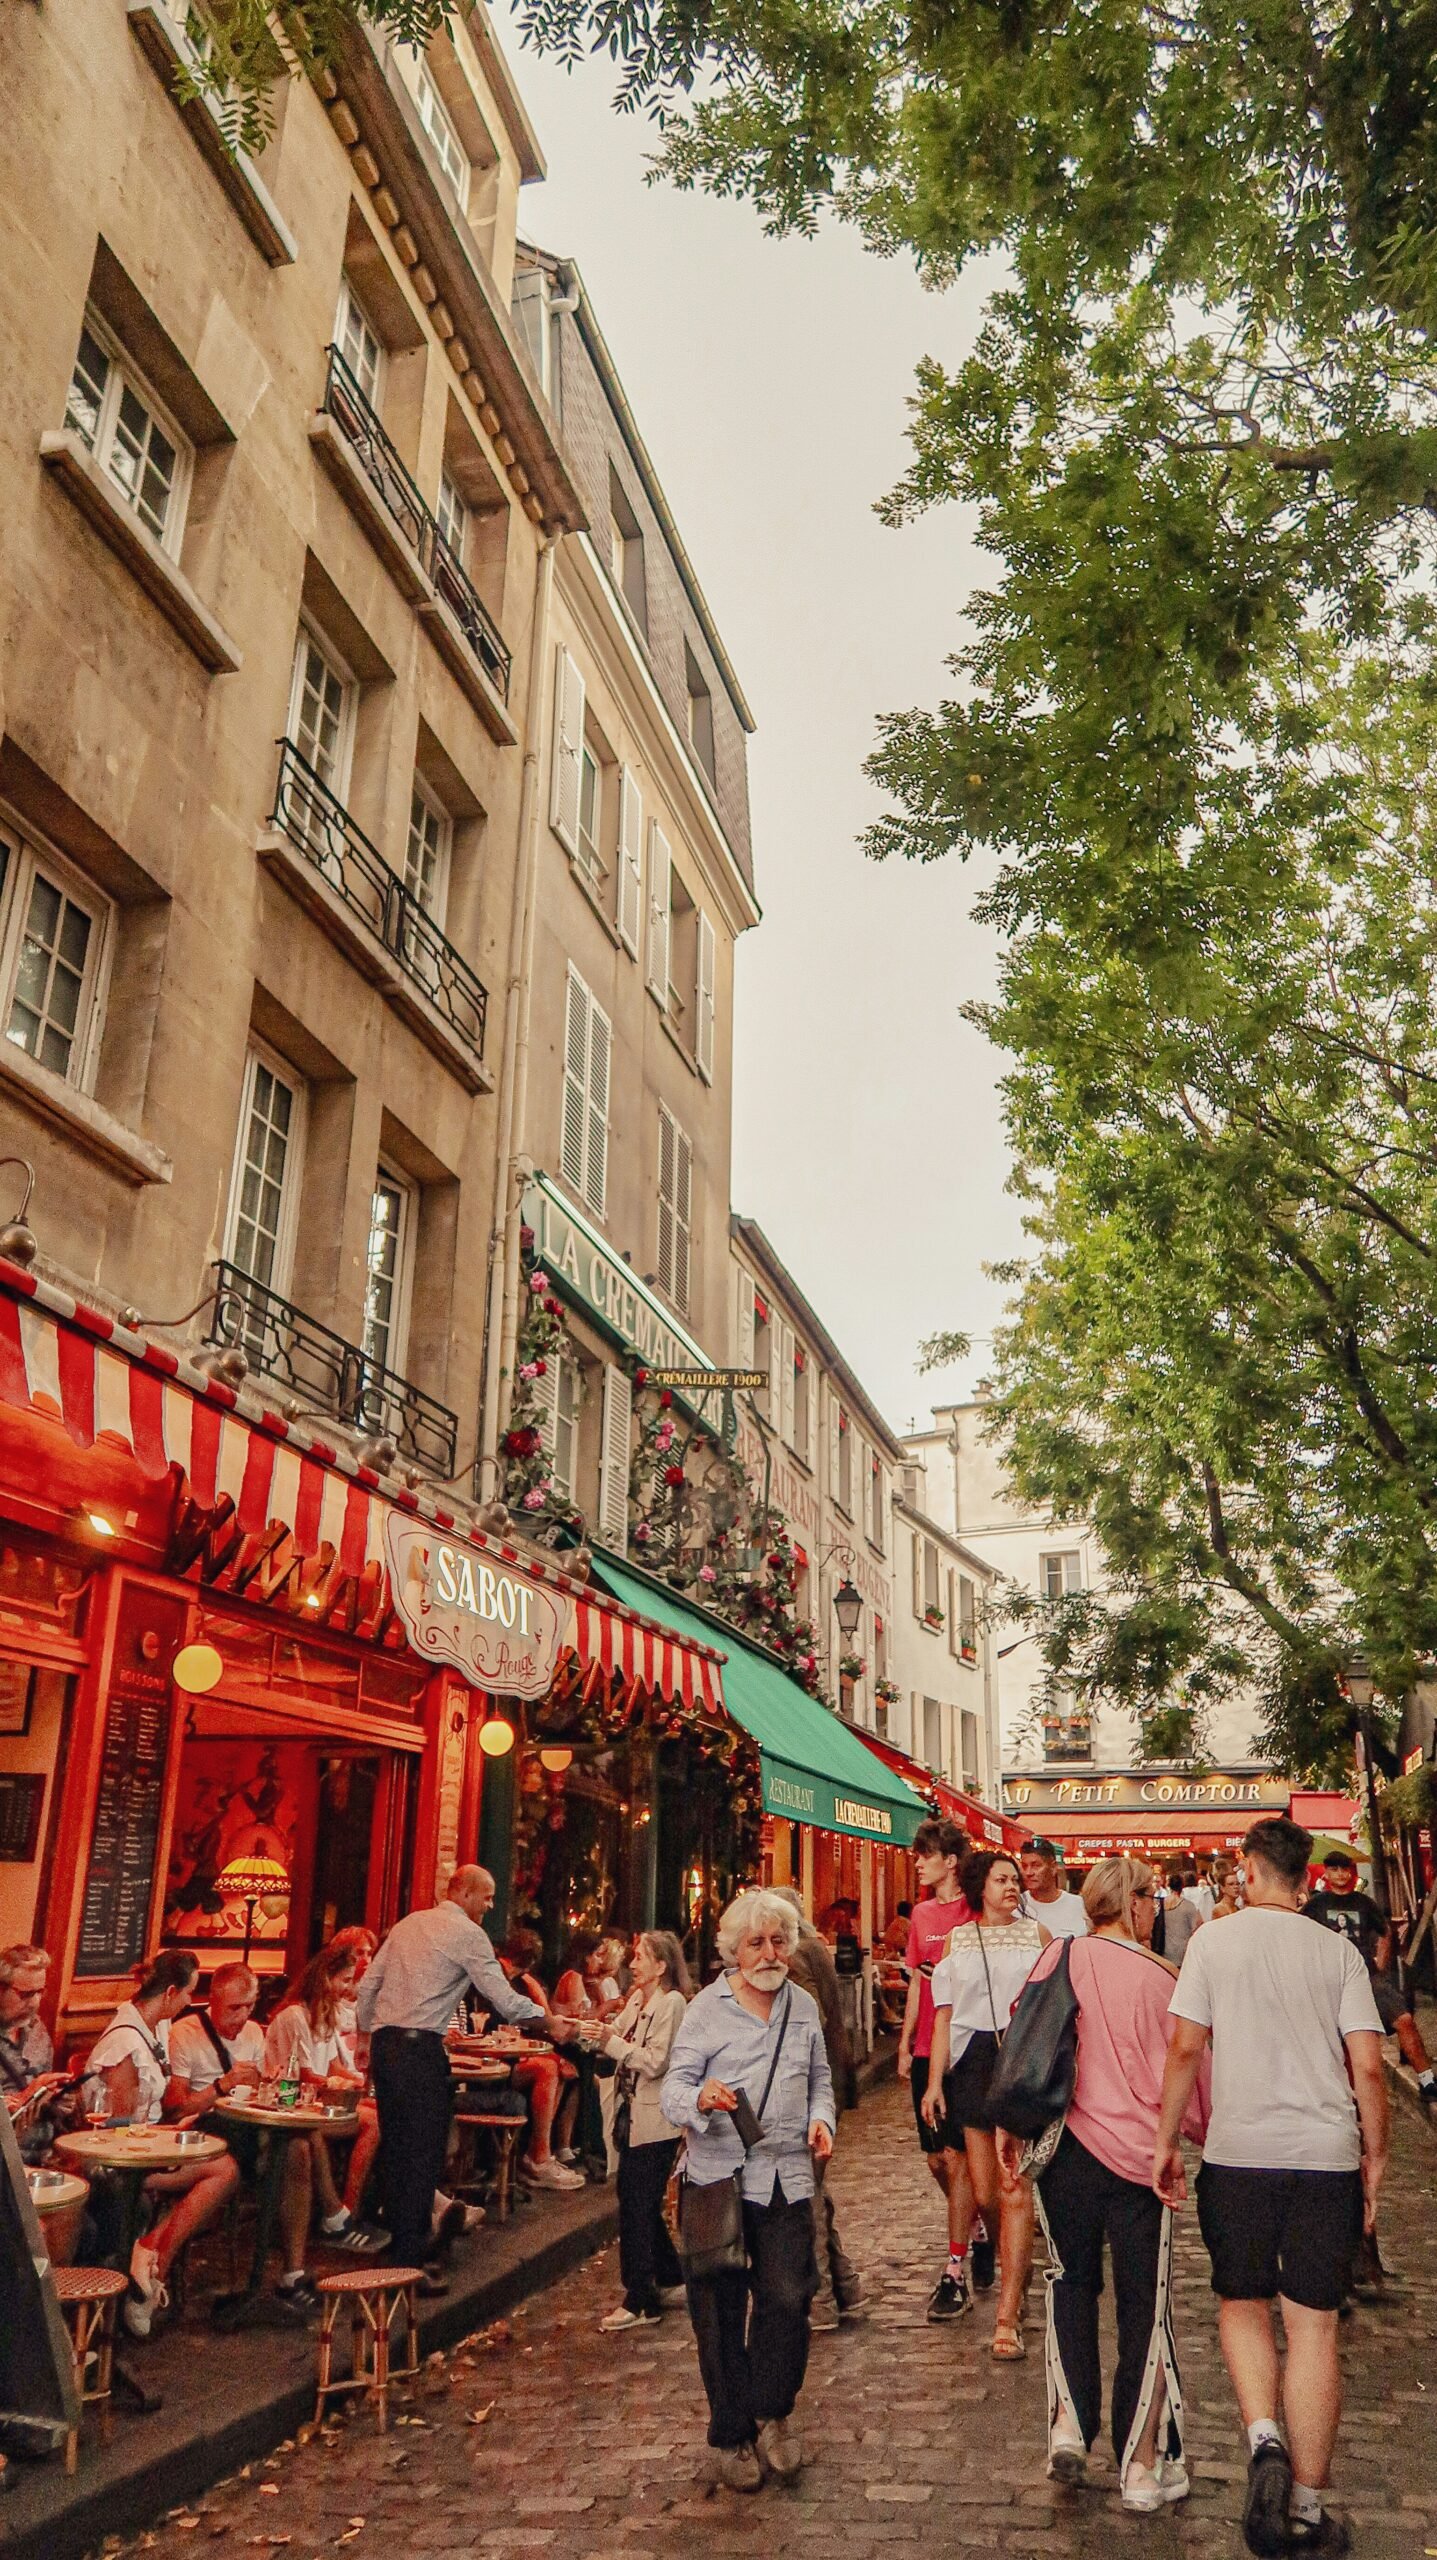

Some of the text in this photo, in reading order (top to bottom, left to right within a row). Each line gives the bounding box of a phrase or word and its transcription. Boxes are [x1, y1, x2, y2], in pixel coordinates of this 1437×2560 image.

[542, 1198, 581, 1287] LA
[733, 1374, 761, 1386] 1900
[736, 1420, 819, 1544] RESAURANT
[437, 1546, 534, 1636] SABOT
[495, 1640, 537, 1684] Rouge
[769, 1776, 815, 1813] RESTAURANT
[1050, 1780, 1119, 1803] PETIT
[1140, 1780, 1261, 1802] COMPTOIR
[1078, 1839, 1113, 1848] CREPES
[1116, 1838, 1145, 1848] PASTA
[1147, 1838, 1192, 1848] BURGERS
